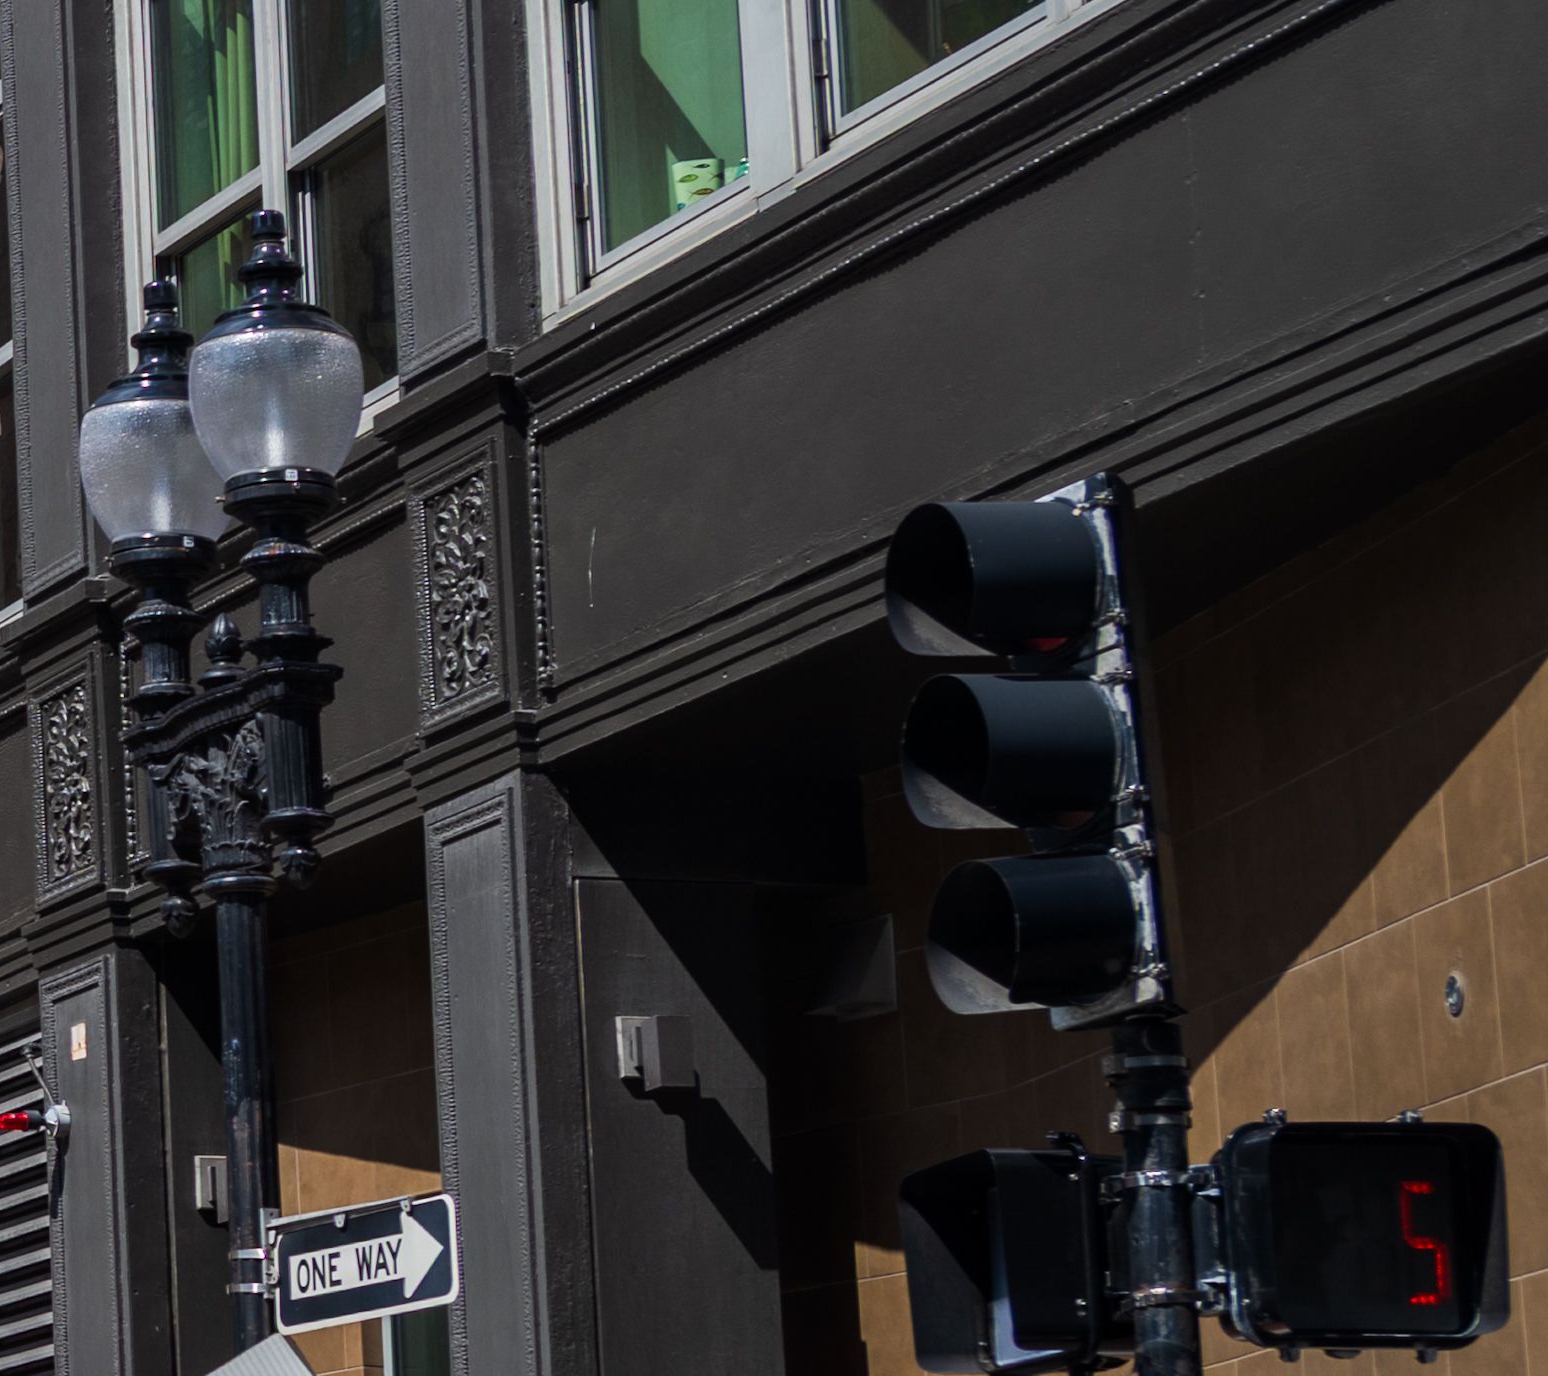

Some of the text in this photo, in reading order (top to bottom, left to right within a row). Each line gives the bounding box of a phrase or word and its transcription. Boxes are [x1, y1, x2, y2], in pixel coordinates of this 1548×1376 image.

[296, 1238, 403, 1294] ONE WAY
[1400, 1180, 1452, 1305] 5
